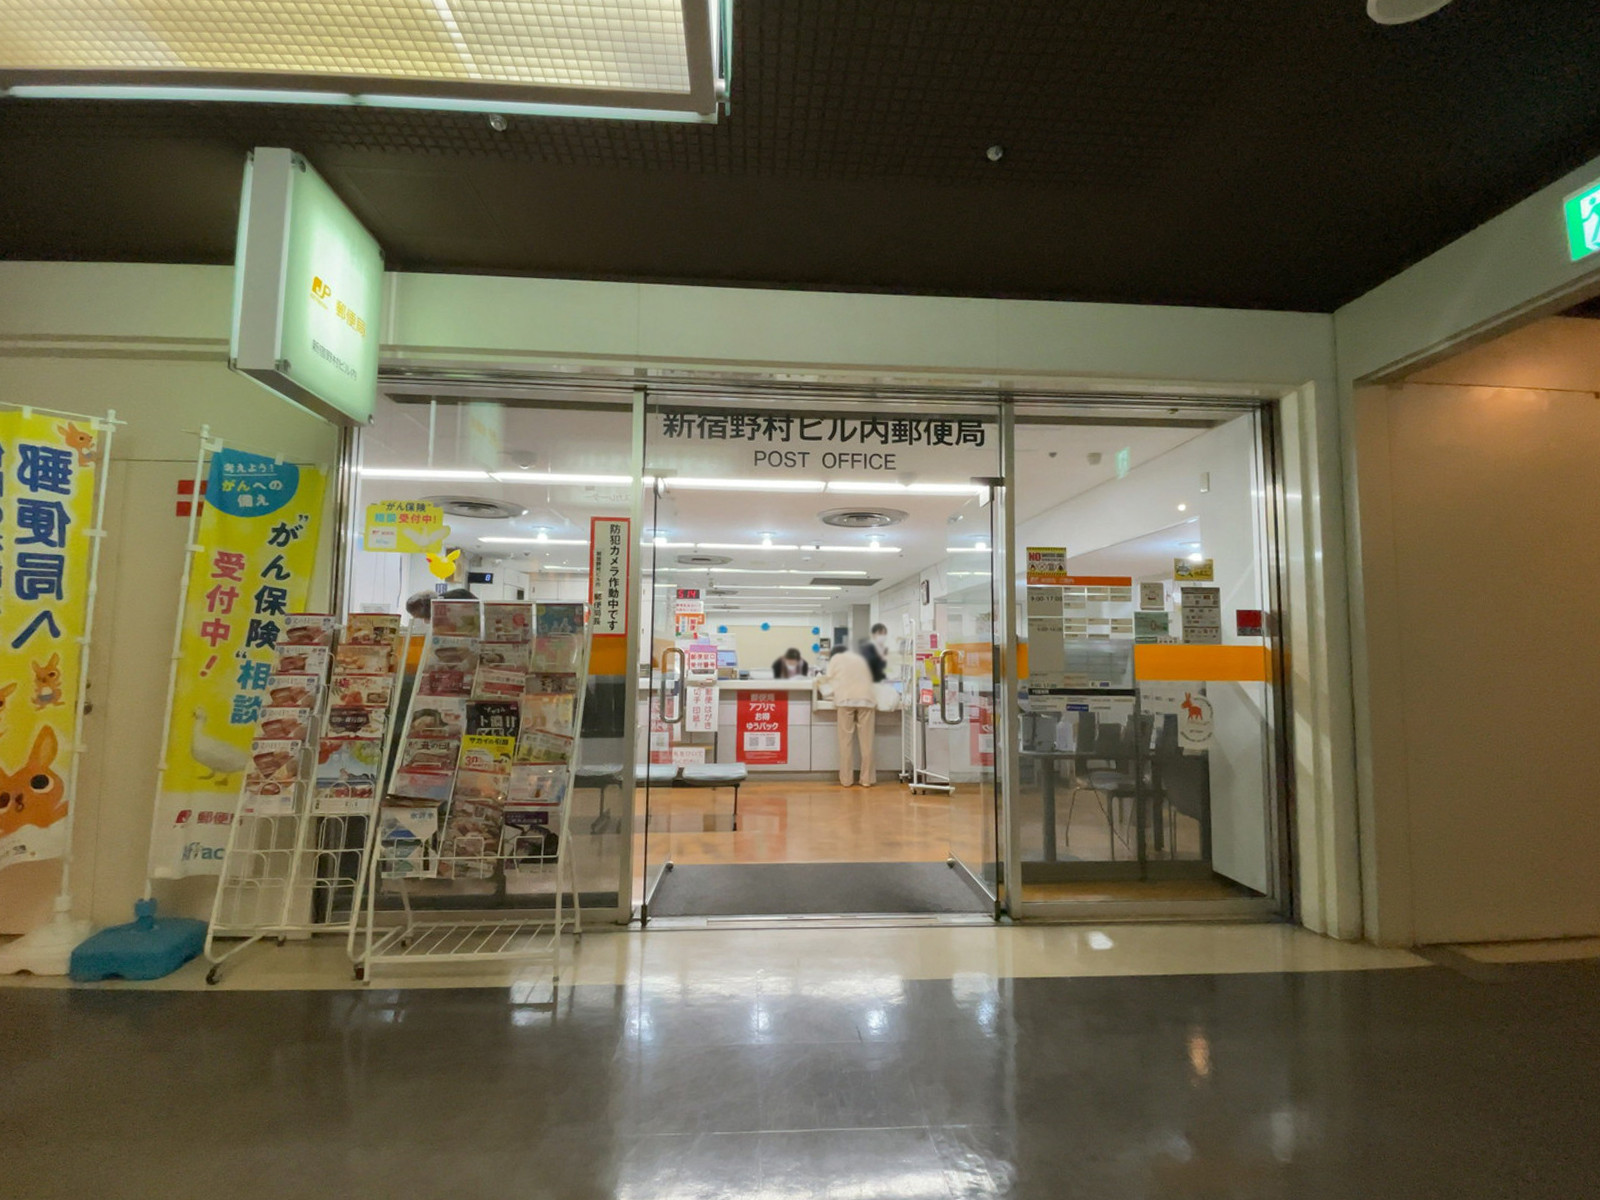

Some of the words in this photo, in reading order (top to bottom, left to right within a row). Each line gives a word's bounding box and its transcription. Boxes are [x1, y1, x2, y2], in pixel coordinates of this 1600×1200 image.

[335, 299, 366, 337] 郵便局
[663, 413, 986, 447] 新宿野村ビル内郵便局
[754, 450, 810, 468] POST
[821, 453, 897, 470] OFFICE
[222, 480, 283, 491] がんへの
[1029, 552, 1041, 561] NO
[608, 523, 621, 631] 防犯カメラ作動中です
[201, 551, 245, 677] 受付中!
[749, 702, 775, 711] アプリで
[746, 722, 778, 730] ゆうパック
